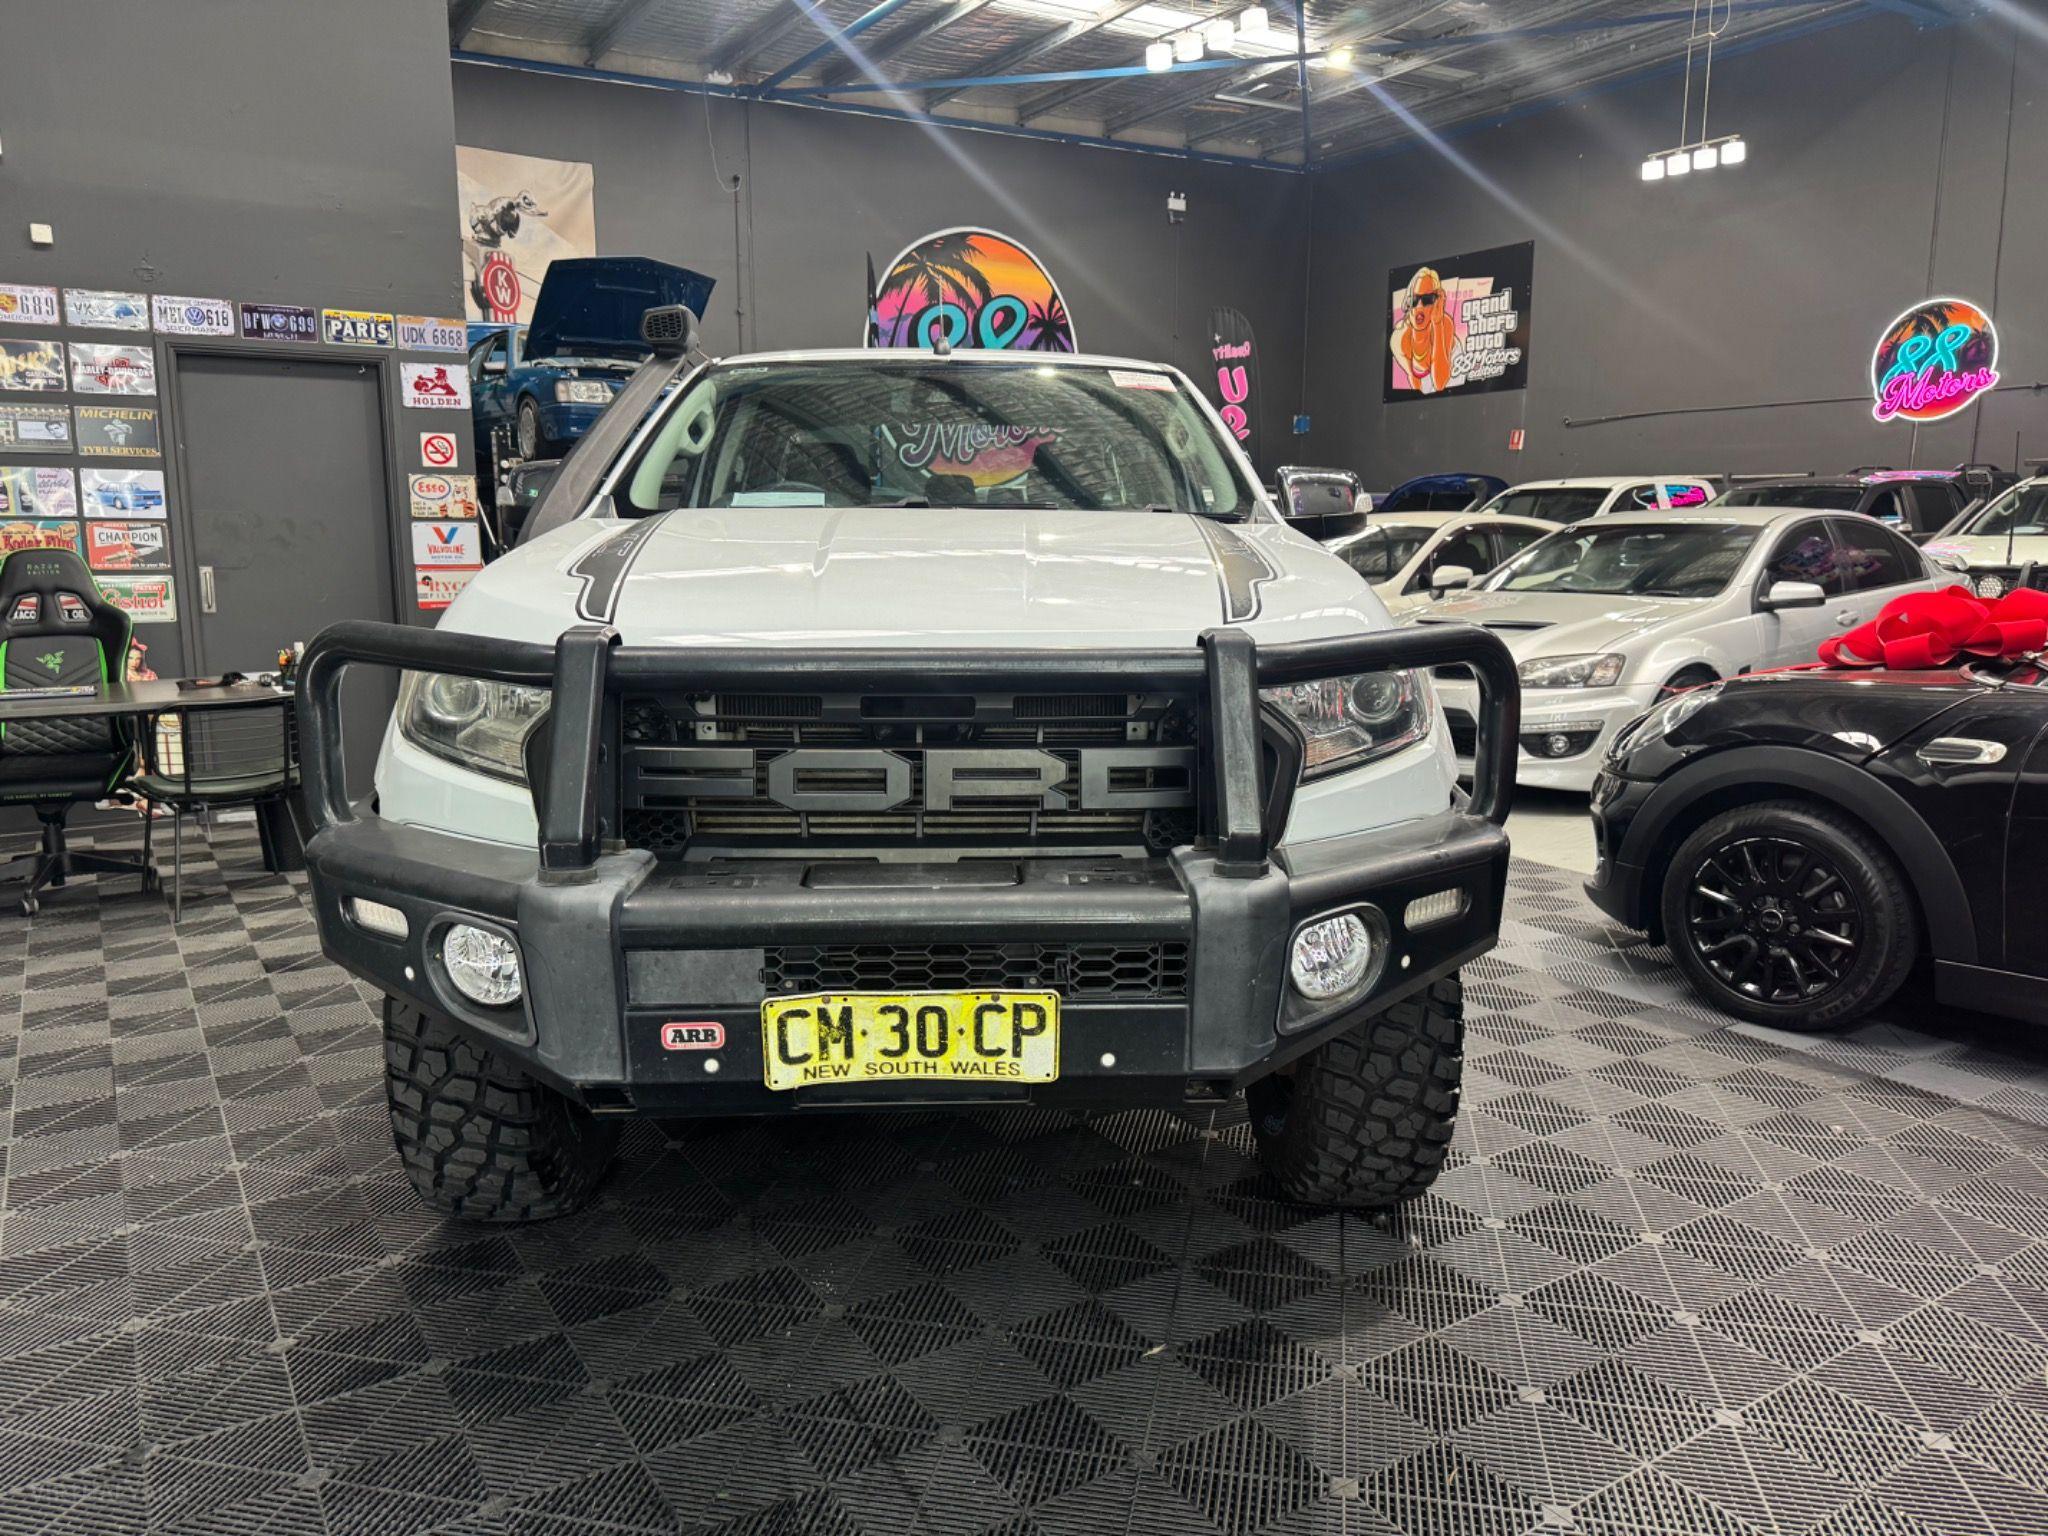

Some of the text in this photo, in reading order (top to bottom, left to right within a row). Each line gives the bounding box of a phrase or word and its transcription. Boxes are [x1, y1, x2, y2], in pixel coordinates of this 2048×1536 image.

[330, 320, 389, 340] PARIS
[402, 325, 463, 347] UDK 6868
[1466, 332, 1504, 352] auto
[413, 397, 461, 406] HOLDEN
[1874, 367, 1996, 420] Motors
[79, 409, 153, 421] MICHELIN
[82, 446, 157, 456] TYRE SERVICES
[418, 481, 446, 493] Esso
[427, 543, 465, 555] VALVOLINE
[620, 746, 1196, 812] FORD
[671, 1029, 717, 1043] ARB
[803, 1061, 1020, 1080] NEW SOUTH WALES
